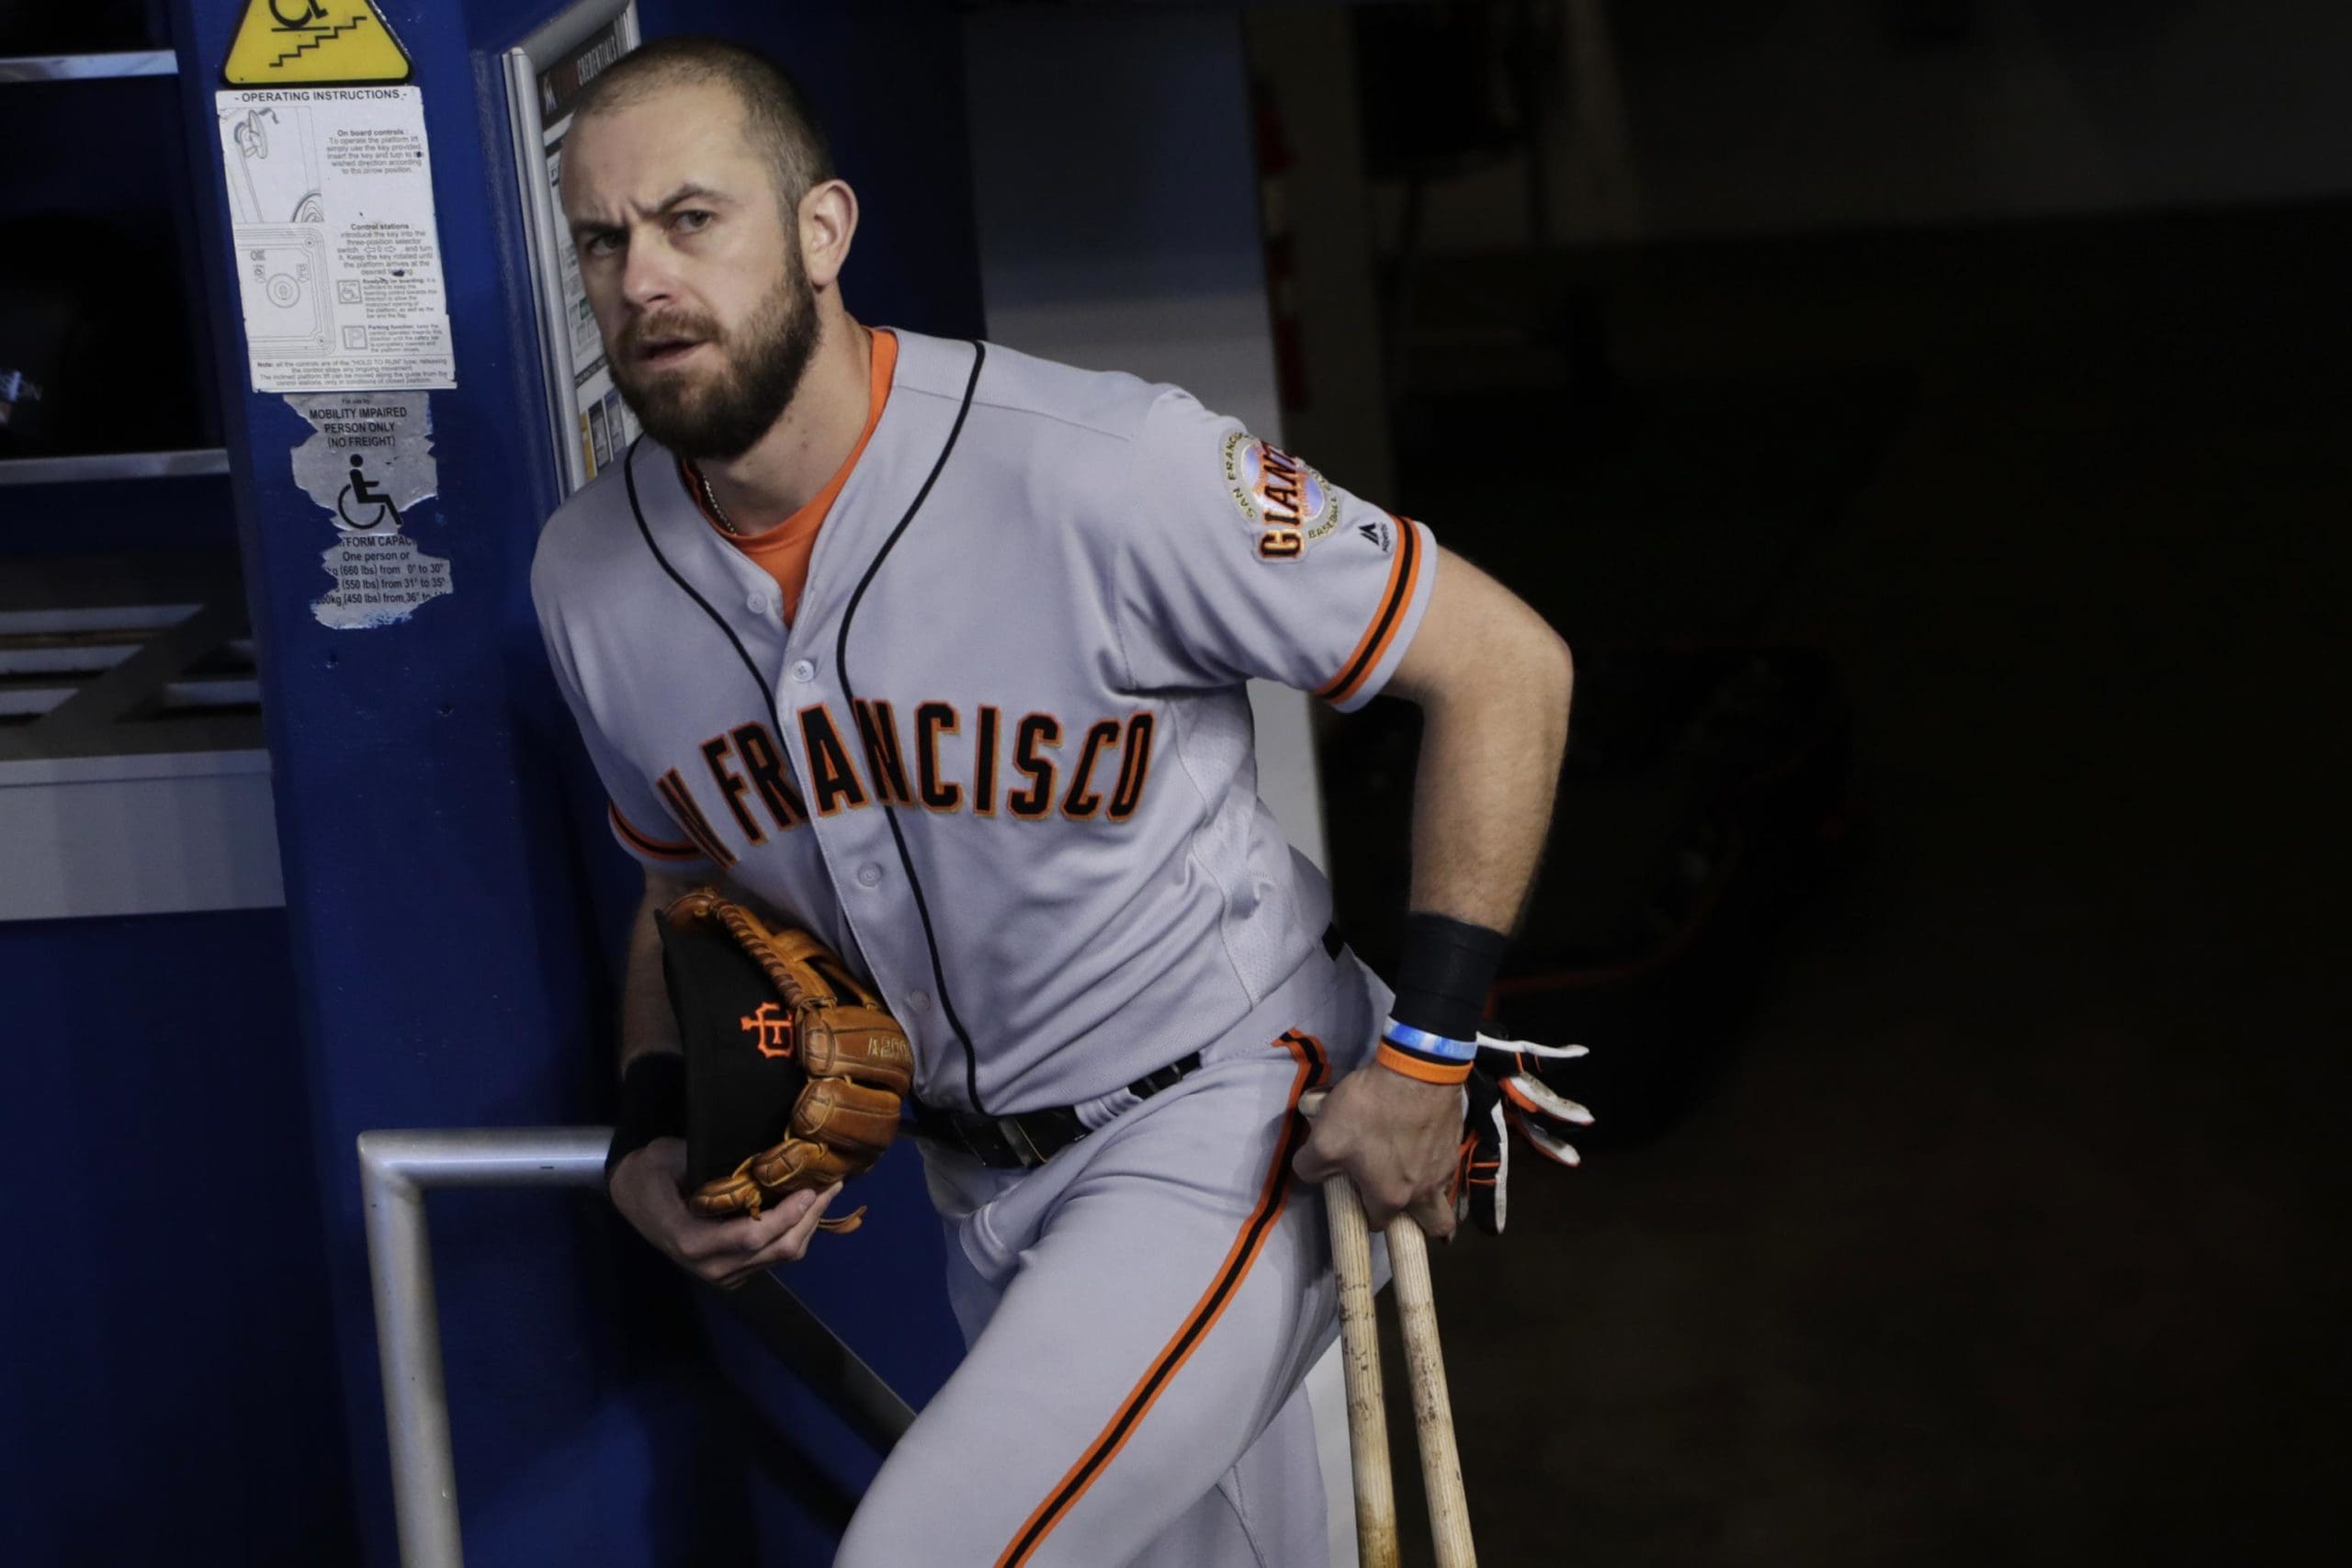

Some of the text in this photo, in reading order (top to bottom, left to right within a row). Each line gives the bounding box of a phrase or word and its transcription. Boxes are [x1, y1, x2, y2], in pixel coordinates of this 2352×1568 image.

[242, 92, 311, 102] OPERATING
[312, 89, 400, 100] INSTRUCTIONS
[310, 407, 407, 419] MOBILITY IMPAIRED
[324, 423, 395, 433] PERSON ONLY
[328, 435, 396, 448] (NO FREIGHT)
[1233, 488, 1256, 518] SAN
[342, 551, 410, 562] One person or
[361, 565, 377, 575] lbs)
[380, 565, 401, 574] from
[419, 564, 427, 573] to
[430, 564, 443, 573] 30°
[342, 579, 360, 590] (550
[363, 579, 379, 589] lbs)
[381, 579, 402, 588] from
[405, 578, 417, 587] 31°
[421, 578, 429, 587] to
[432, 577, 446, 586] 35°
[344, 592, 362, 604] (450
[365, 592, 381, 603] lbs)
[383, 593, 404, 603] from
[406, 592, 419, 602] 36°
[698, 698, 1155, 846] FRANCISCO
